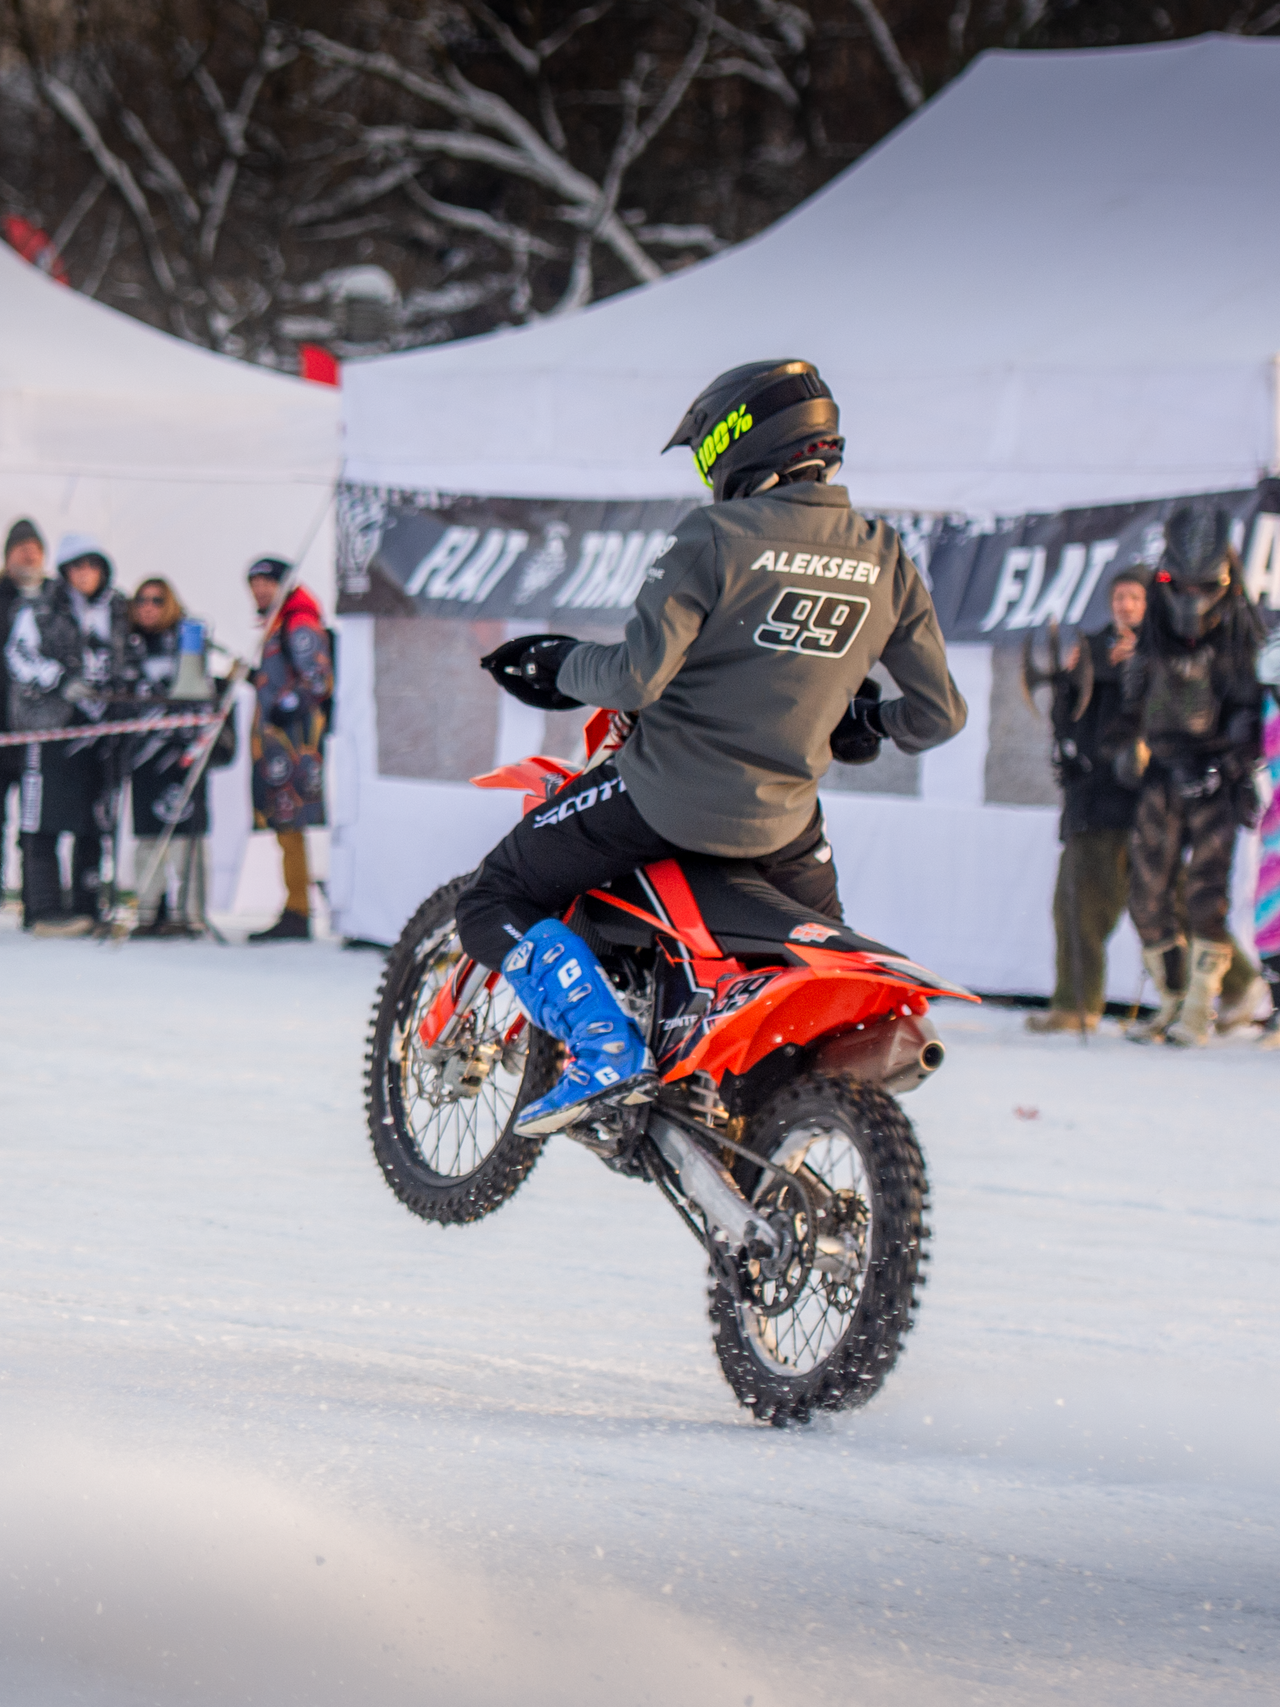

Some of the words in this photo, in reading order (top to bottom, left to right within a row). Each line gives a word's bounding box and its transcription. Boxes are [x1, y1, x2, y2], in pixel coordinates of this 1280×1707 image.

[694, 403, 753, 475] 100%
[404, 524, 529, 604] FLAT
[751, 550, 880, 584] ALEKSEEV
[982, 540, 1119, 632] FLAT
[753, 586, 870, 658] 99
